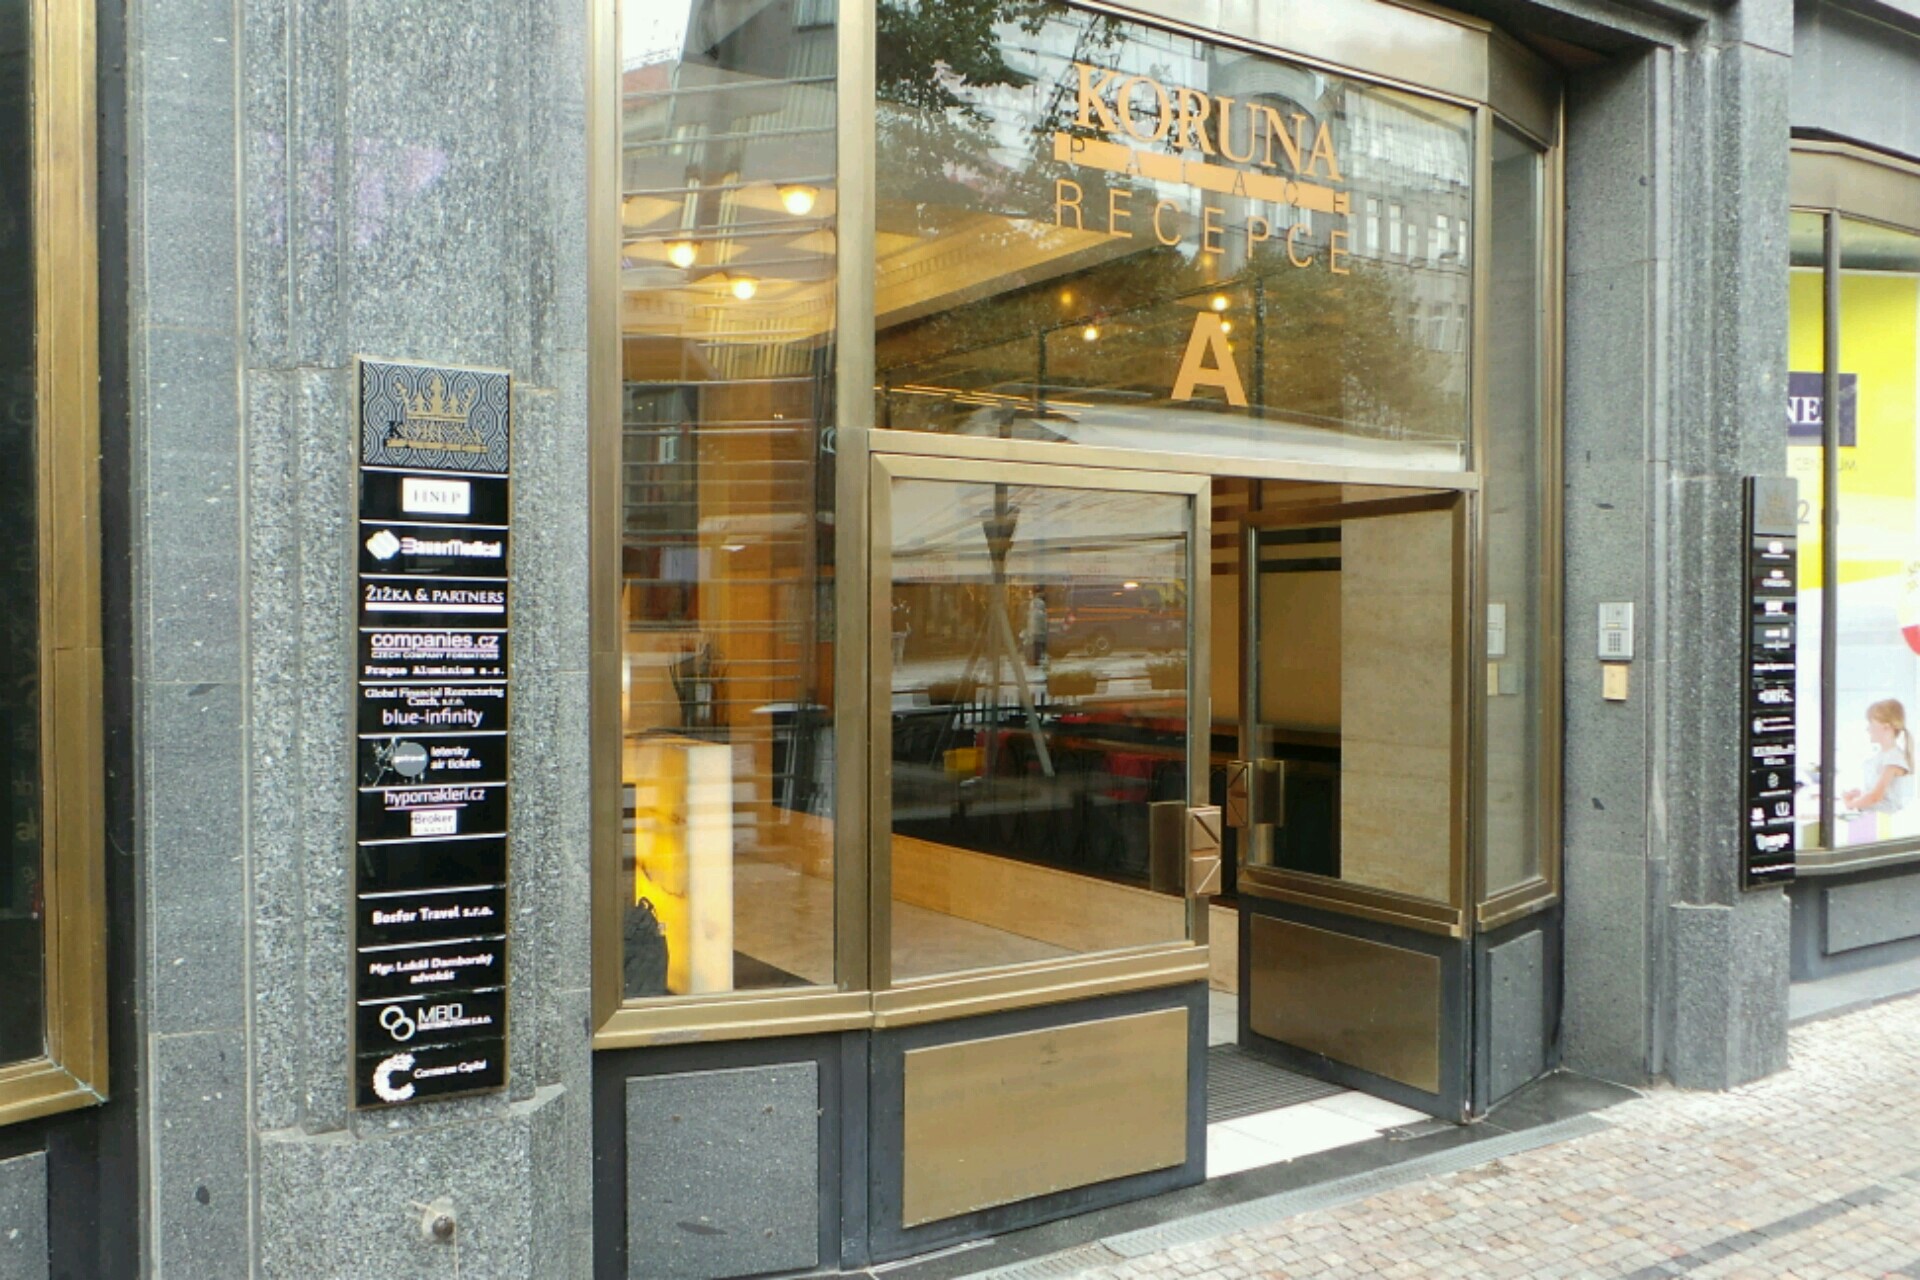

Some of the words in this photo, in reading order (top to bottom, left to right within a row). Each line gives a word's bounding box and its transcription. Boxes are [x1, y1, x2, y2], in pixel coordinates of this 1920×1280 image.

[1072, 62, 1344, 182] KORUNA
[1055, 179, 1350, 275] RECEPCE
[1171, 311, 1249, 408] A
[1787, 396, 1824, 424] NE
[415, 588, 429, 602] &
[432, 590, 505, 603] PARTNERS
[371, 631, 499, 651] companies.cz
[382, 709, 483, 728] blue-infinity
[372, 908, 417, 925] Bosfor
[419, 905, 460, 921] Travel
[462, 906, 494, 917] s.r.o.
[418, 1003, 463, 1023] MBD
